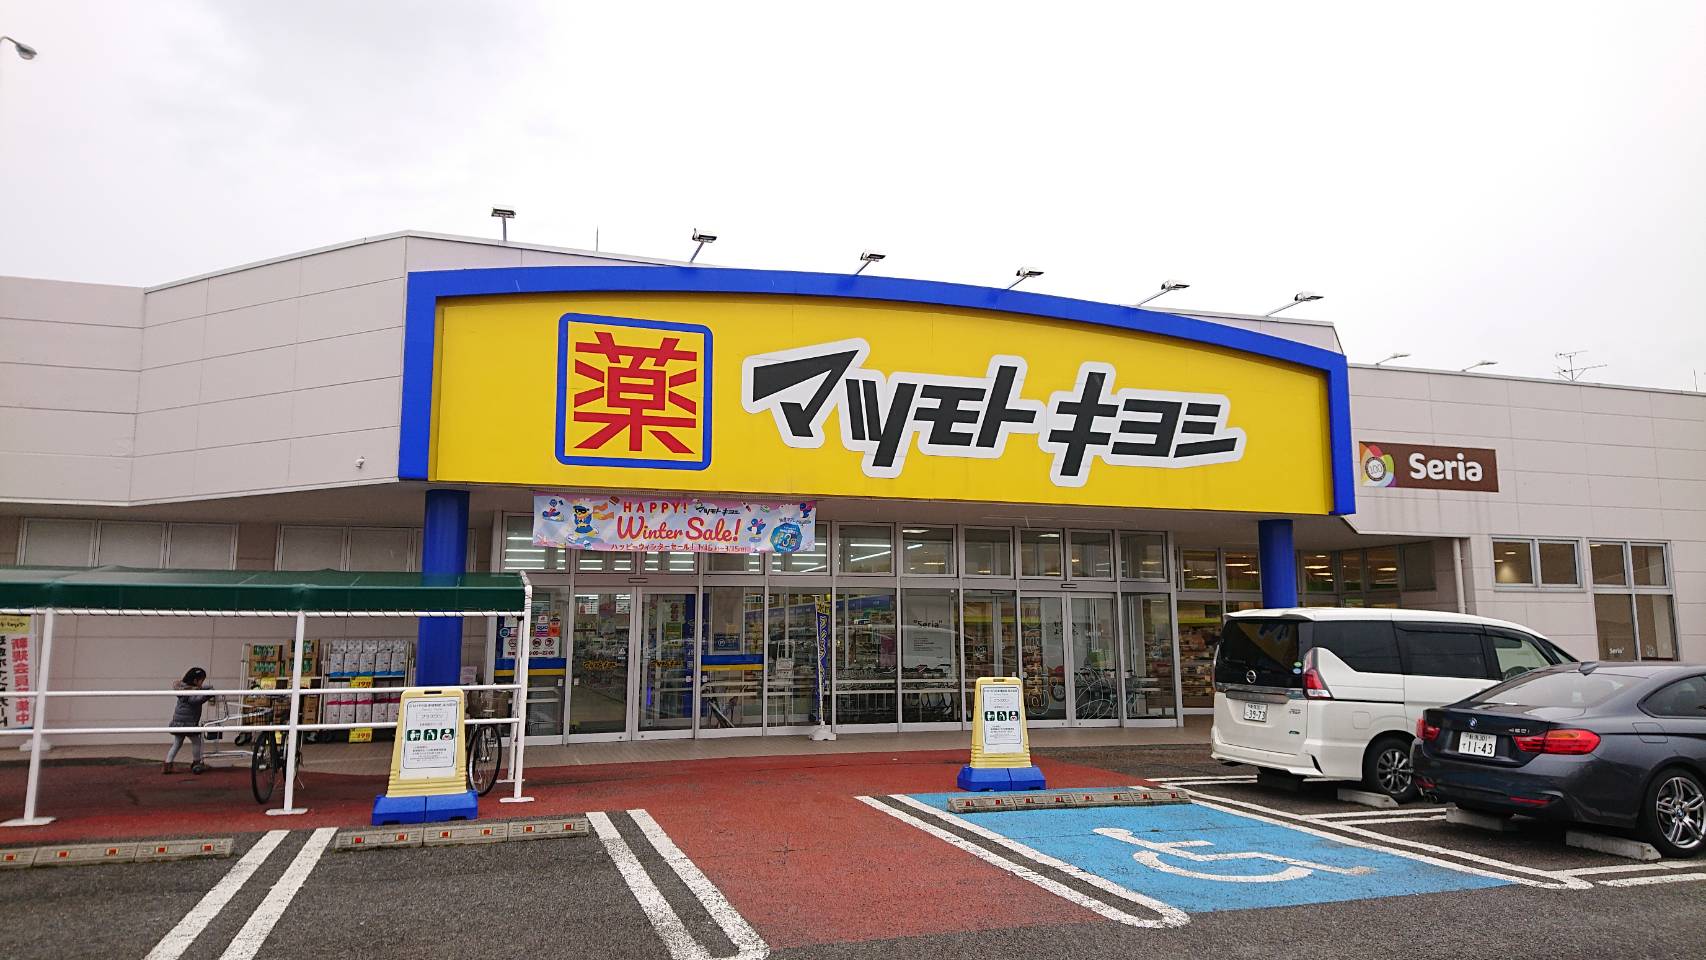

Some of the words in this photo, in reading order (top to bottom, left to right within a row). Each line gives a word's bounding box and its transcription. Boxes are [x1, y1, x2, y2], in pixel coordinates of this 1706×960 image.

[573, 330, 697, 455] 薬
[752, 349, 1237, 478] マツモトキヨシ
[1408, 452, 1483, 482] Seria
[623, 501, 688, 515] HAPPY!
[616, 515, 684, 540] Winter
[685, 516, 742, 542] Sale!
[1467, 741, 1493, 755] 11-43
